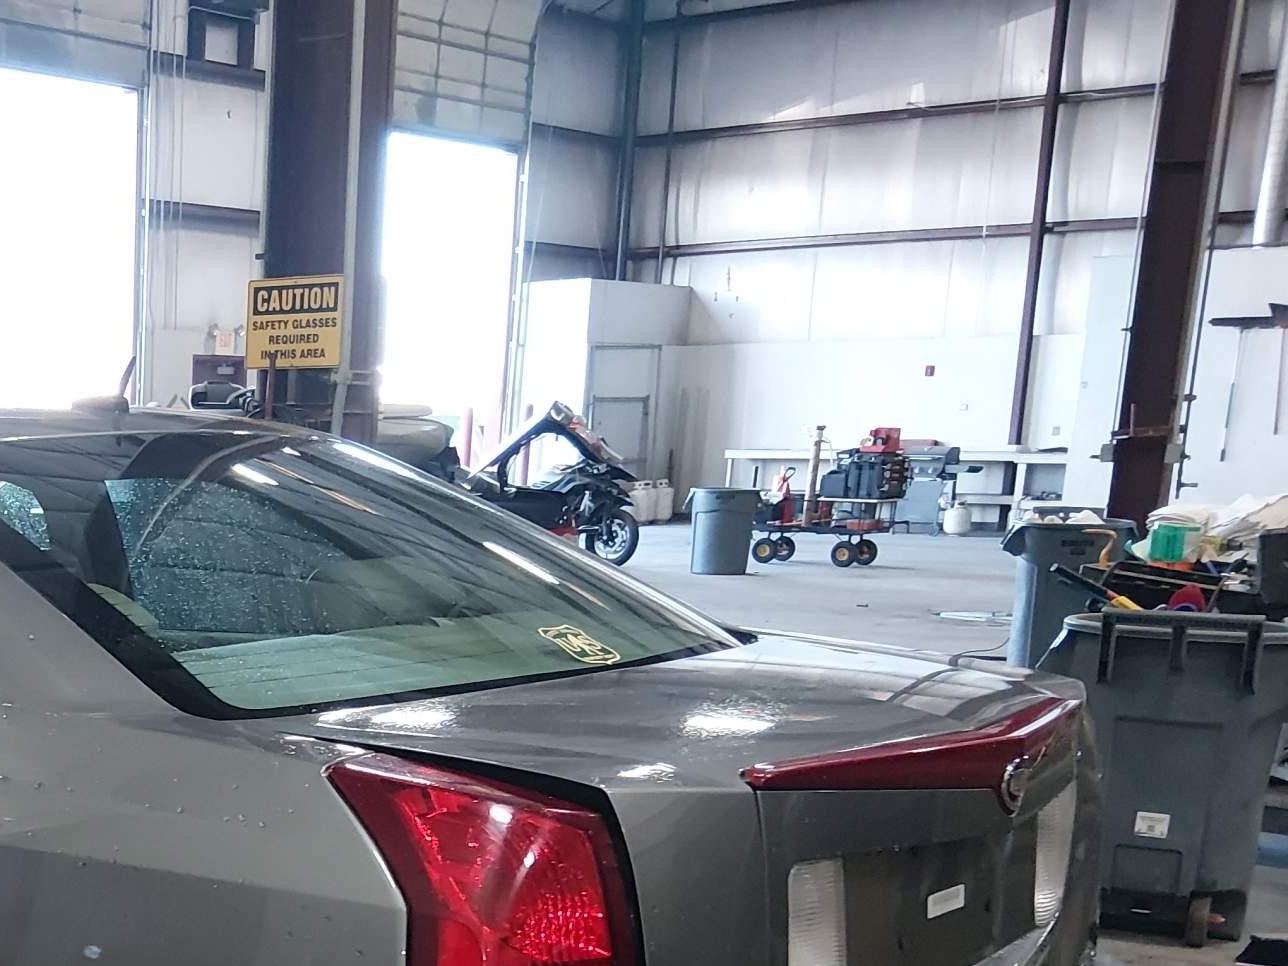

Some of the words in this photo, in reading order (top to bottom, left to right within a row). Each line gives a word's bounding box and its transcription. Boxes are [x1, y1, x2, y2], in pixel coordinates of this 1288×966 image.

[256, 286, 335, 312] CAUTION
[252, 319, 289, 331] SAFETY
[292, 317, 337, 329] GLASSES
[268, 333, 320, 345] REQUIRED
[274, 348, 297, 360] THIS
[299, 347, 326, 359] AREA
